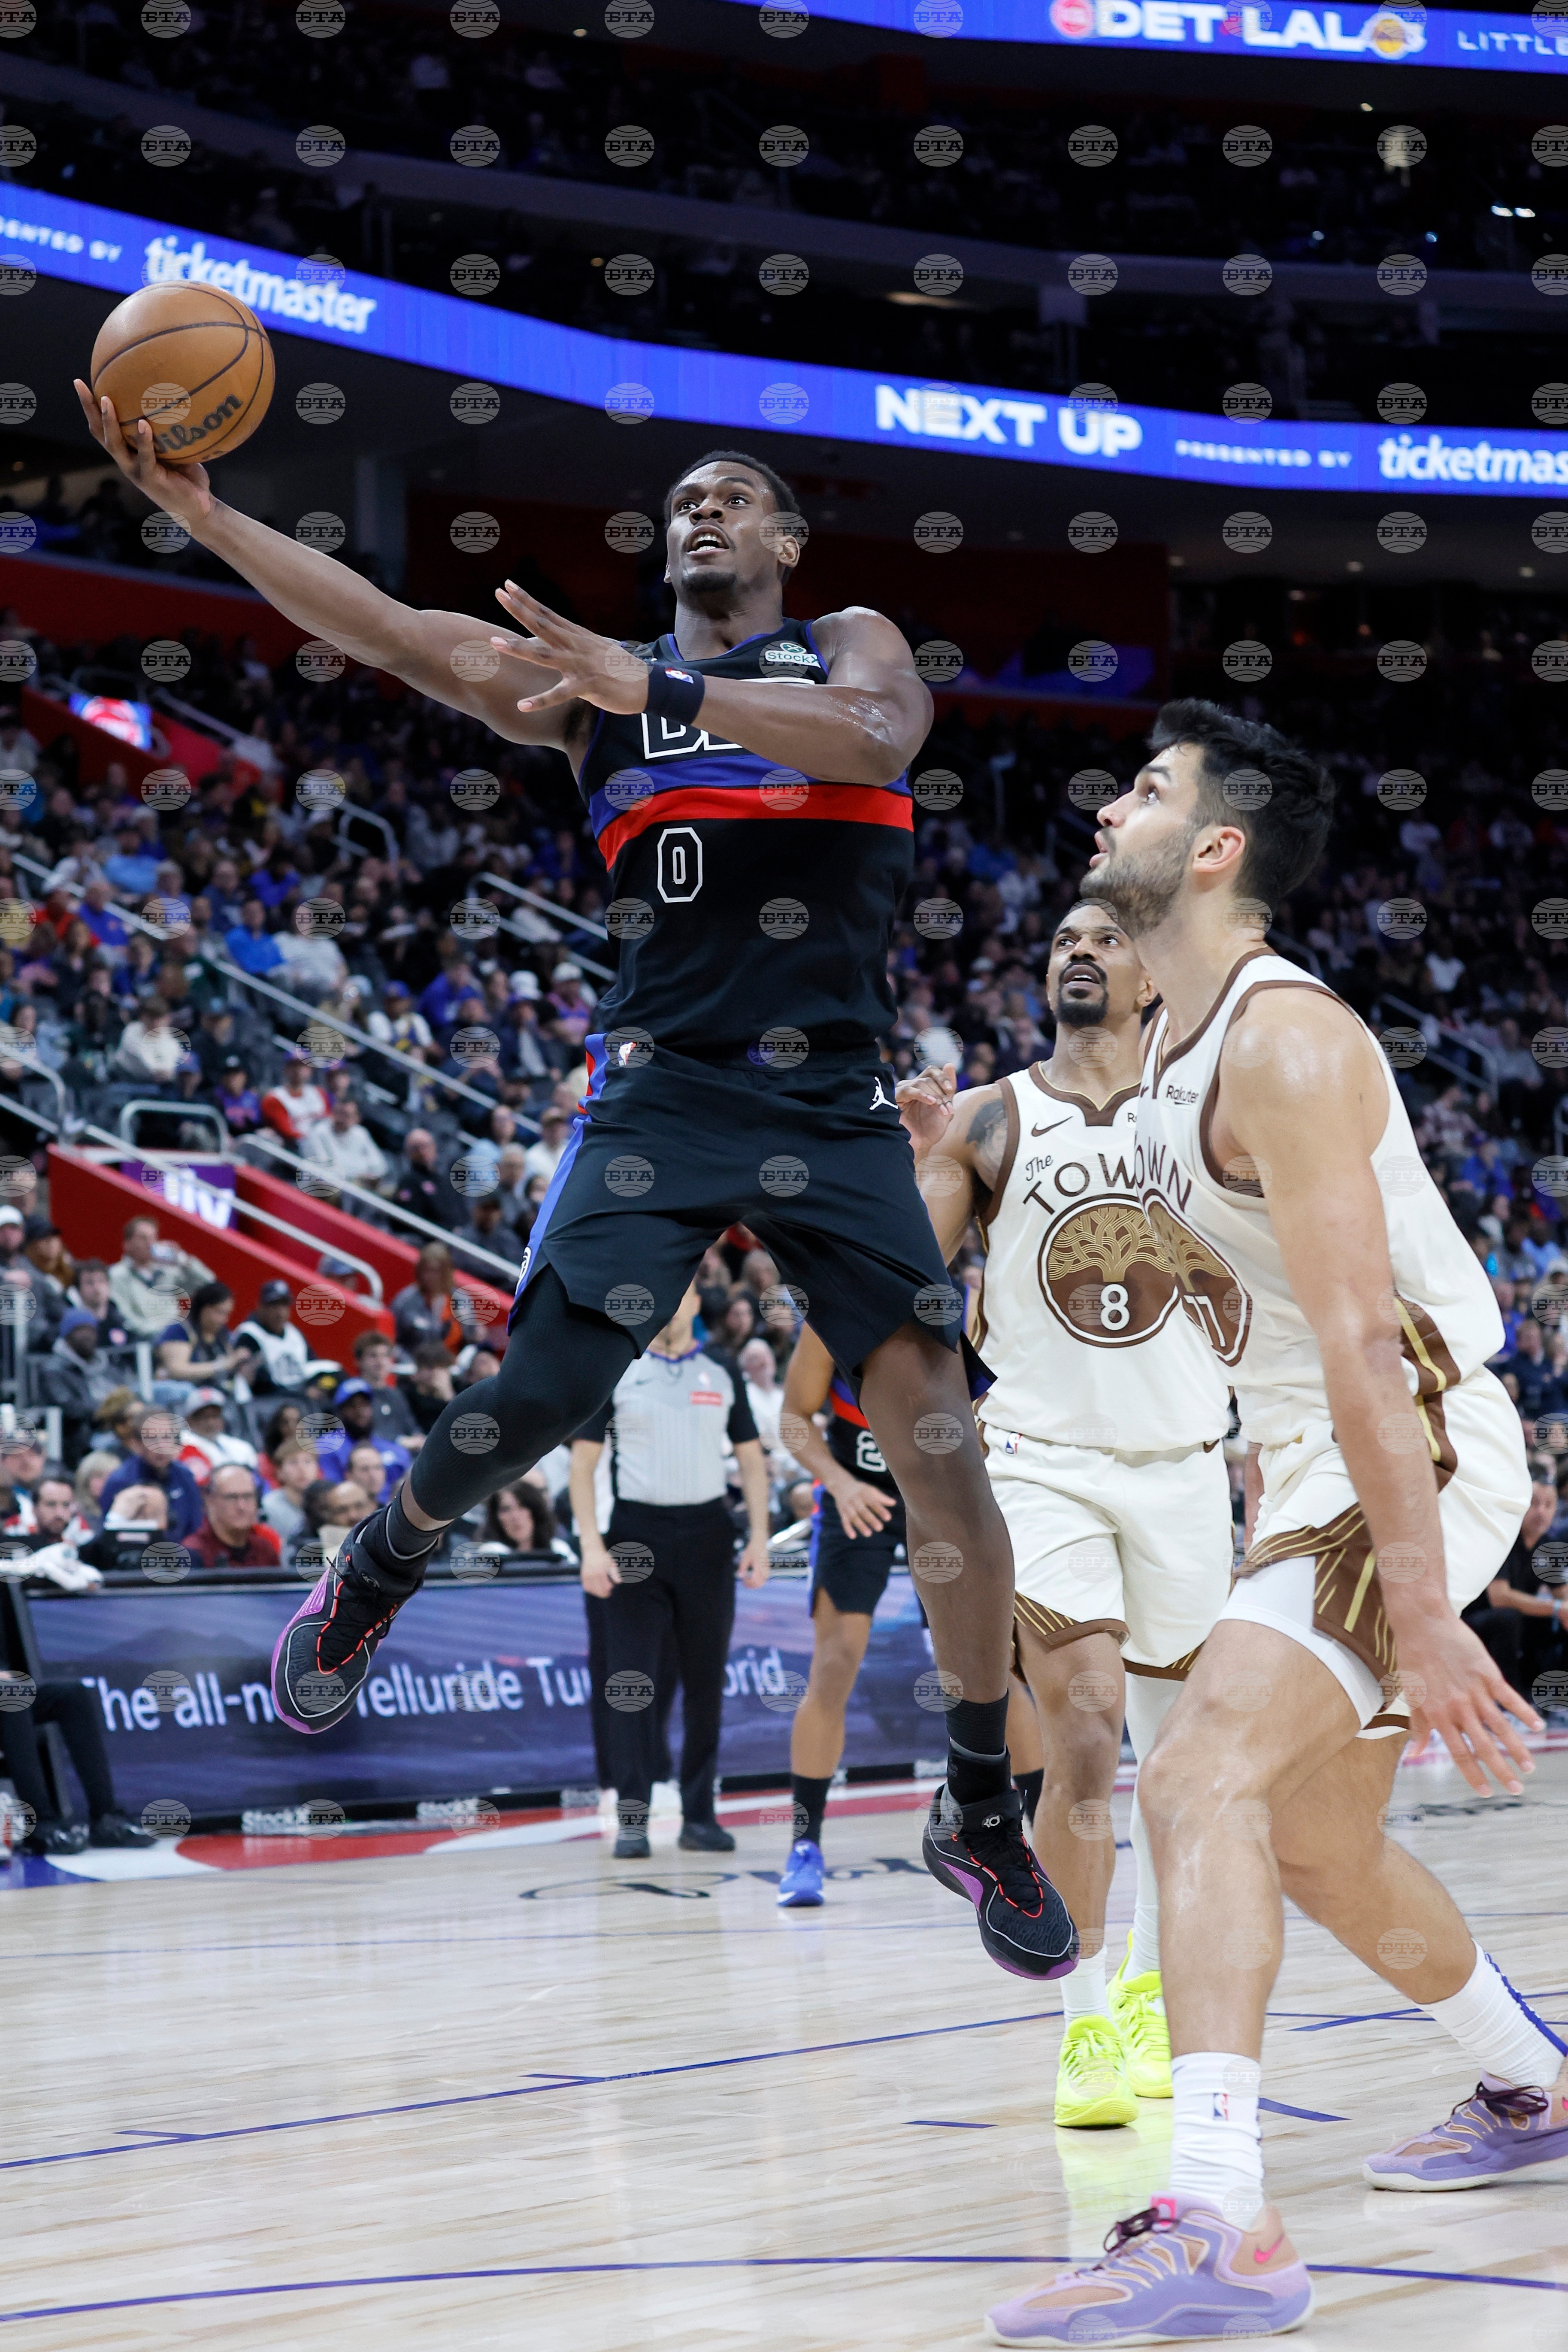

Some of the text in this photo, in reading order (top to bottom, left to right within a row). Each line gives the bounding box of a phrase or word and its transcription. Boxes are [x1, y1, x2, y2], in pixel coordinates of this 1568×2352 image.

[1096, 0, 1226, 42] DET
[144, 234, 378, 334] ticketmaster
[875, 384, 1046, 447] NEXT
[1058, 409, 1143, 457] UP
[1318, 450, 1352, 468] BY
[657, 827, 702, 903] 0
[1023, 1153, 1135, 1215] TOW
[1026, 1154, 1053, 1182] The
[1135, 1133, 1192, 1213] OWN
[1100, 1284, 1129, 1331] 8
[82, 1676, 161, 1731] he
[174, 1671, 274, 1729] all-n
